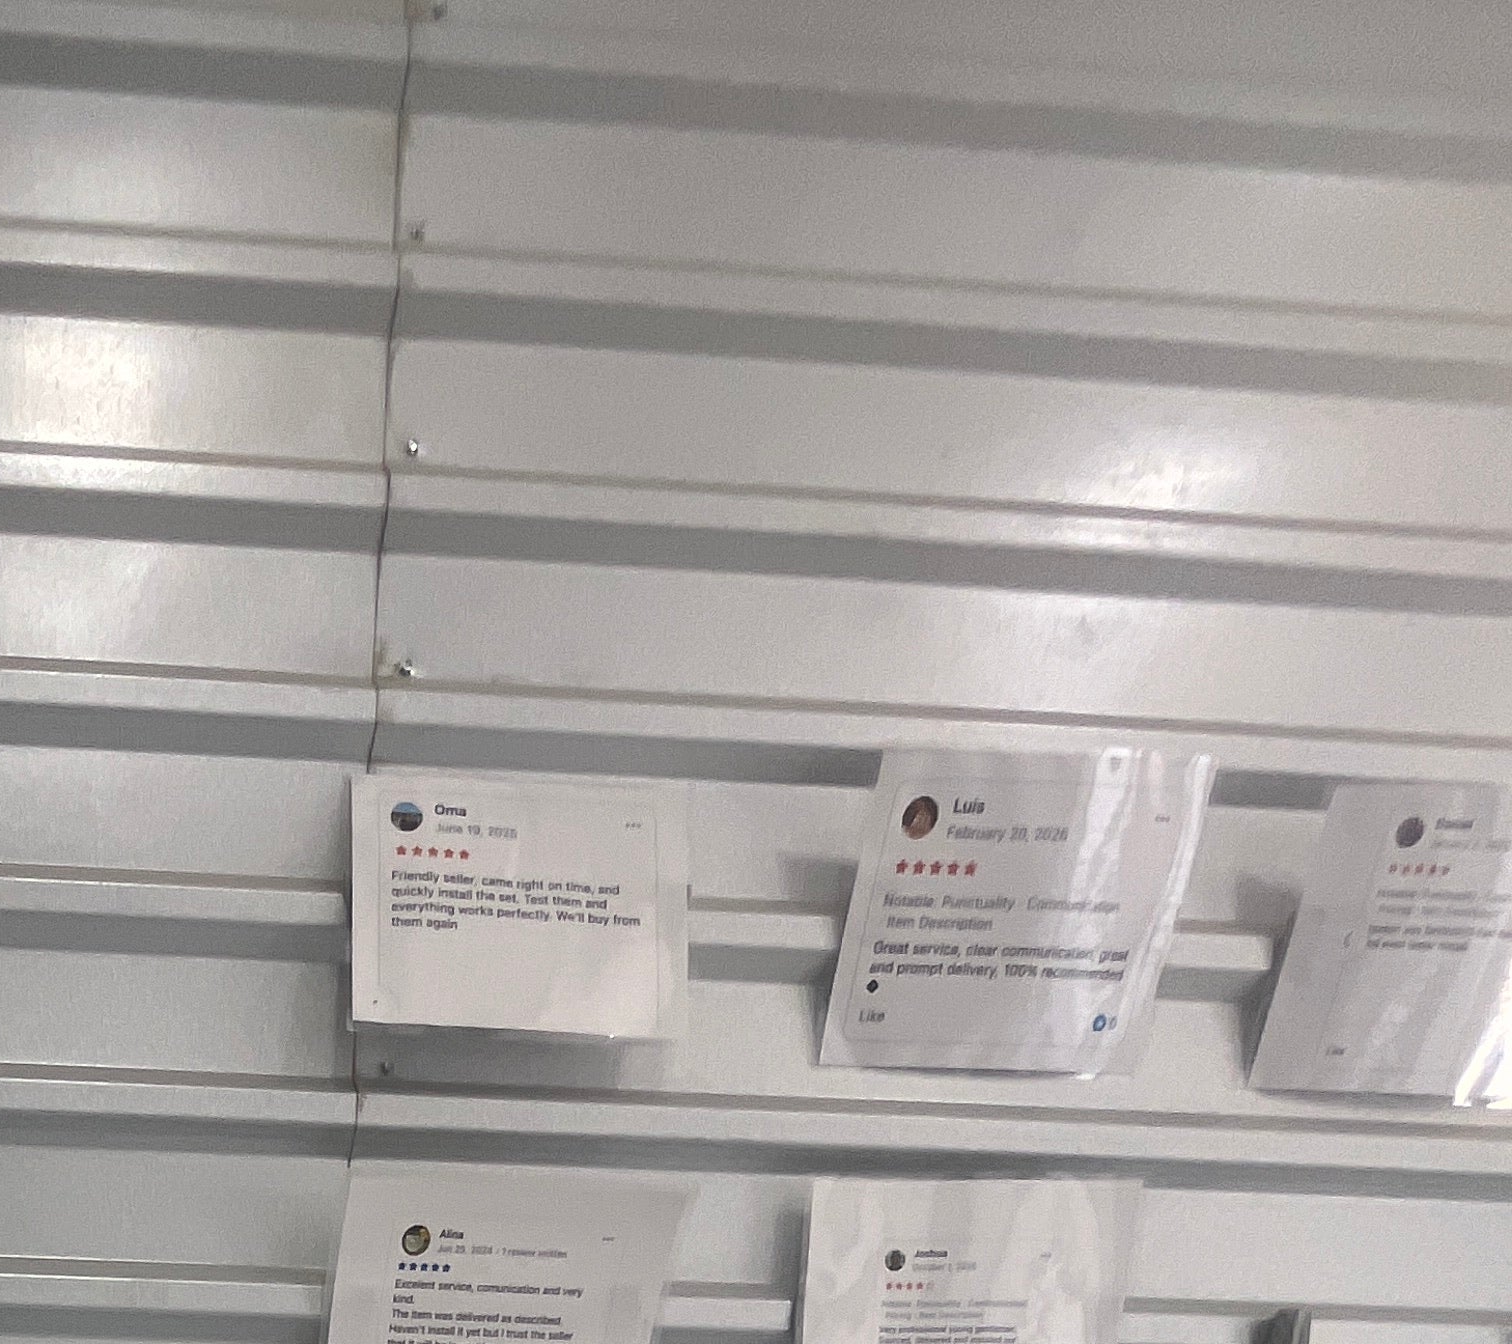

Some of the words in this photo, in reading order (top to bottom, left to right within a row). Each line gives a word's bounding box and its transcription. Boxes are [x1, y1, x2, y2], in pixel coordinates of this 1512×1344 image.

[953, 798, 985, 814] Luis
[947, 827, 1005, 843] February
[392, 871, 439, 884] Friendly
[443, 873, 477, 886] seller,
[481, 877, 513, 888] came
[517, 879, 543, 892] right
[548, 881, 562, 891] on
[566, 881, 595, 894] time,
[598, 885, 620, 895] and
[391, 886, 434, 899] quickly
[438, 889, 472, 901] install
[476, 890, 495, 902] the
[499, 893, 520, 903] set.
[525, 894, 548, 905] Test
[552, 895, 582, 907] them
[585, 899, 607, 909] and
[391, 902, 454, 916] everything
[458, 905, 493, 917] works
[556, 912, 584, 923] We'll
[588, 913, 609, 926] buy
[613, 915, 641, 926] from
[391, 916, 422, 927] them
[426, 918, 458, 931] again
[873, 941, 909, 955] Great
[869, 963, 893, 975] and
[896, 964, 943, 978] prompt
[859, 1010, 885, 1022] Like
[543, 1286, 560, 1295] and
[392, 1309, 410, 1319] The
[506, 1328, 528, 1339] trust
[531, 1330, 546, 1339] the
